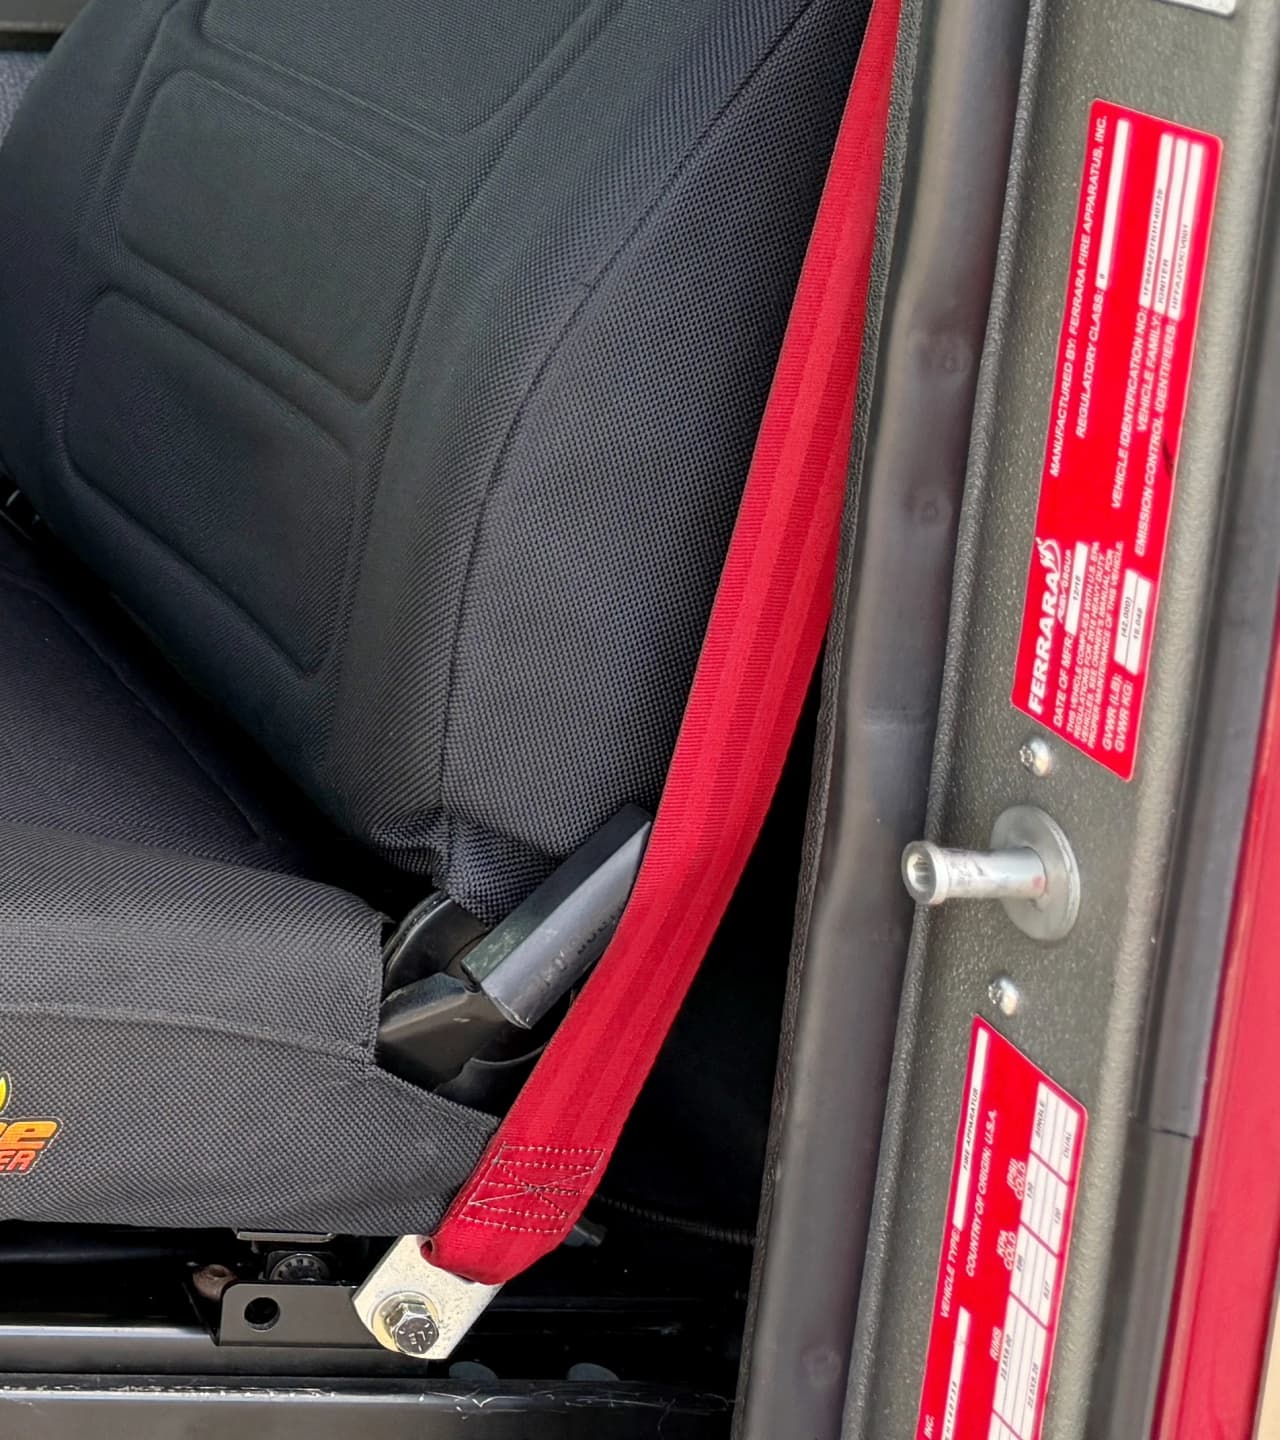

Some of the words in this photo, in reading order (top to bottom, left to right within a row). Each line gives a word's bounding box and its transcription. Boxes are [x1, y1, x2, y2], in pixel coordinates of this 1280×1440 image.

[1094, 114, 1106, 142] INC.
[1082, 145, 1103, 233] APPARATUS,
[1077, 233, 1090, 266] FIRE
[1068, 268, 1086, 335] FERRARA
[1075, 342, 1096, 438] REGULATORY
[1088, 289, 1104, 340] CLASS:
[1136, 369, 1154, 431] VEHICLE
[1145, 313, 1161, 367] FAMILY:
[1119, 335, 1144, 447] IDENTIFICATION
[1049, 362, 1073, 476] MANUFACTURED
[1134, 485, 1153, 557] EMISSION
[1144, 414, 1163, 485] CONTROL
[1154, 319, 1176, 413] IDENTIFIERS:
[1111, 447, 1128, 508] VEHICLE
[1061, 548, 1072, 586] GROUP
[1084, 582, 1093, 610] WITH
[1107, 587, 1116, 610] THIS
[1076, 611, 1089, 664] COMPLIES
[1087, 669, 1096, 689] SEE
[1098, 574, 1109, 617] MANUAL
[1104, 548, 1113, 570] FOR
[1104, 613, 1112, 627] OF
[1027, 570, 1059, 714] FERRARA
[1074, 666, 1089, 739] REGULATIONS
[1084, 643, 1093, 665] FOR
[1090, 584, 1100, 616] HEAVY
[1095, 552, 1105, 582] DUTY
[1058, 667, 1069, 689] OF
[1070, 666, 1082, 708] VEHICLE
[1093, 629, 1110, 704] MAINTENANCE
[1053, 692, 1066, 727] DATE
[1066, 710, 1075, 732] THIS
[1087, 705, 1099, 748] PROPER
[1102, 706, 1117, 750] GVWR
[1114, 708, 1129, 752] GVWR
[965, 1212, 982, 1278] COUNTRY
[974, 1195, 985, 1216] OF
[983, 1108, 997, 1145] U.S.A.
[1013, 1161, 1027, 1200] COLD
[995, 1228, 1008, 1259] KPA
[1003, 1230, 1017, 1270] COLD
[940, 1263, 956, 1318] VEHICLE
[989, 1325, 1002, 1361] RIMS
